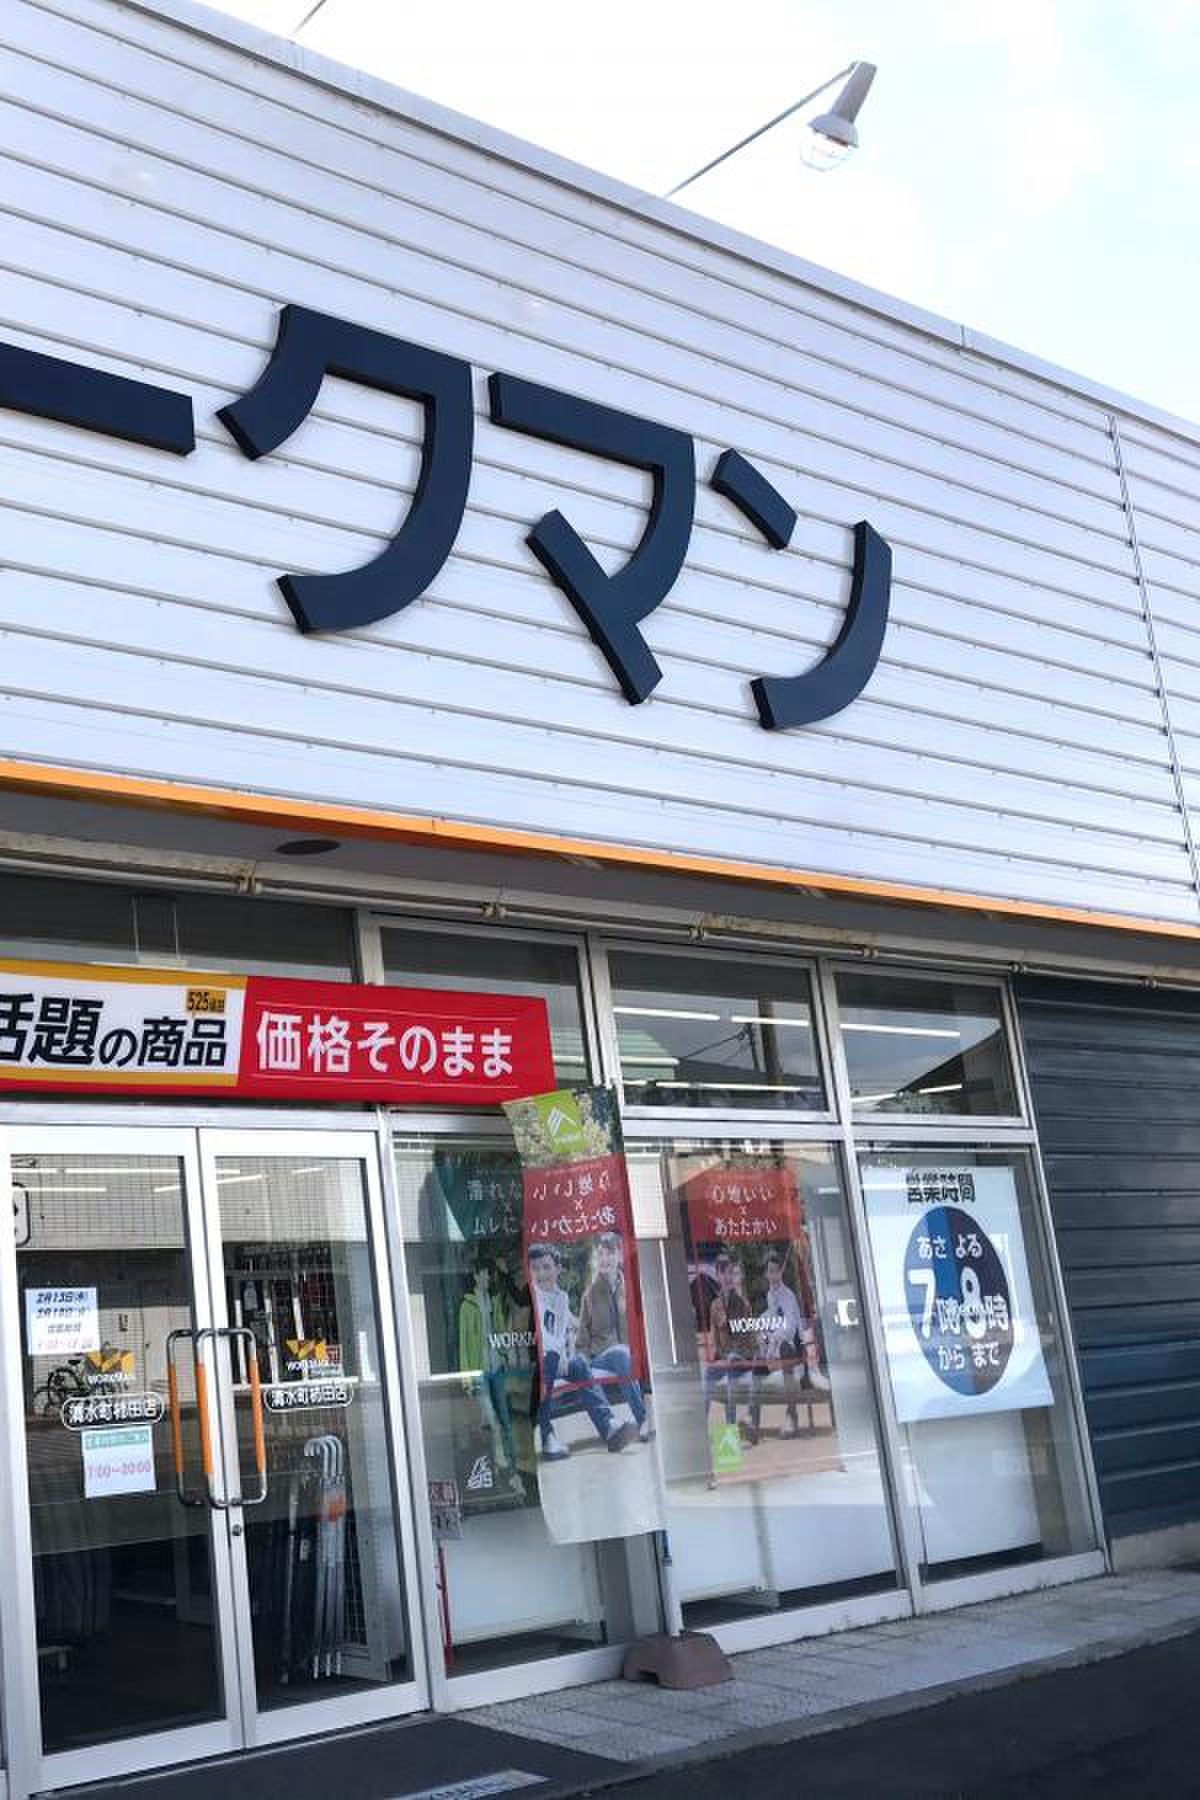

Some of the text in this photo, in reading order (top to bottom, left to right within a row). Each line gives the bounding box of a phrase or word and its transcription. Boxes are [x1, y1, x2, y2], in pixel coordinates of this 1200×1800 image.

[256, 1010, 513, 1077] 価格そのまま
[916, 1233, 983, 1260] あさ よる
[938, 1341, 1000, 1371] から まで
